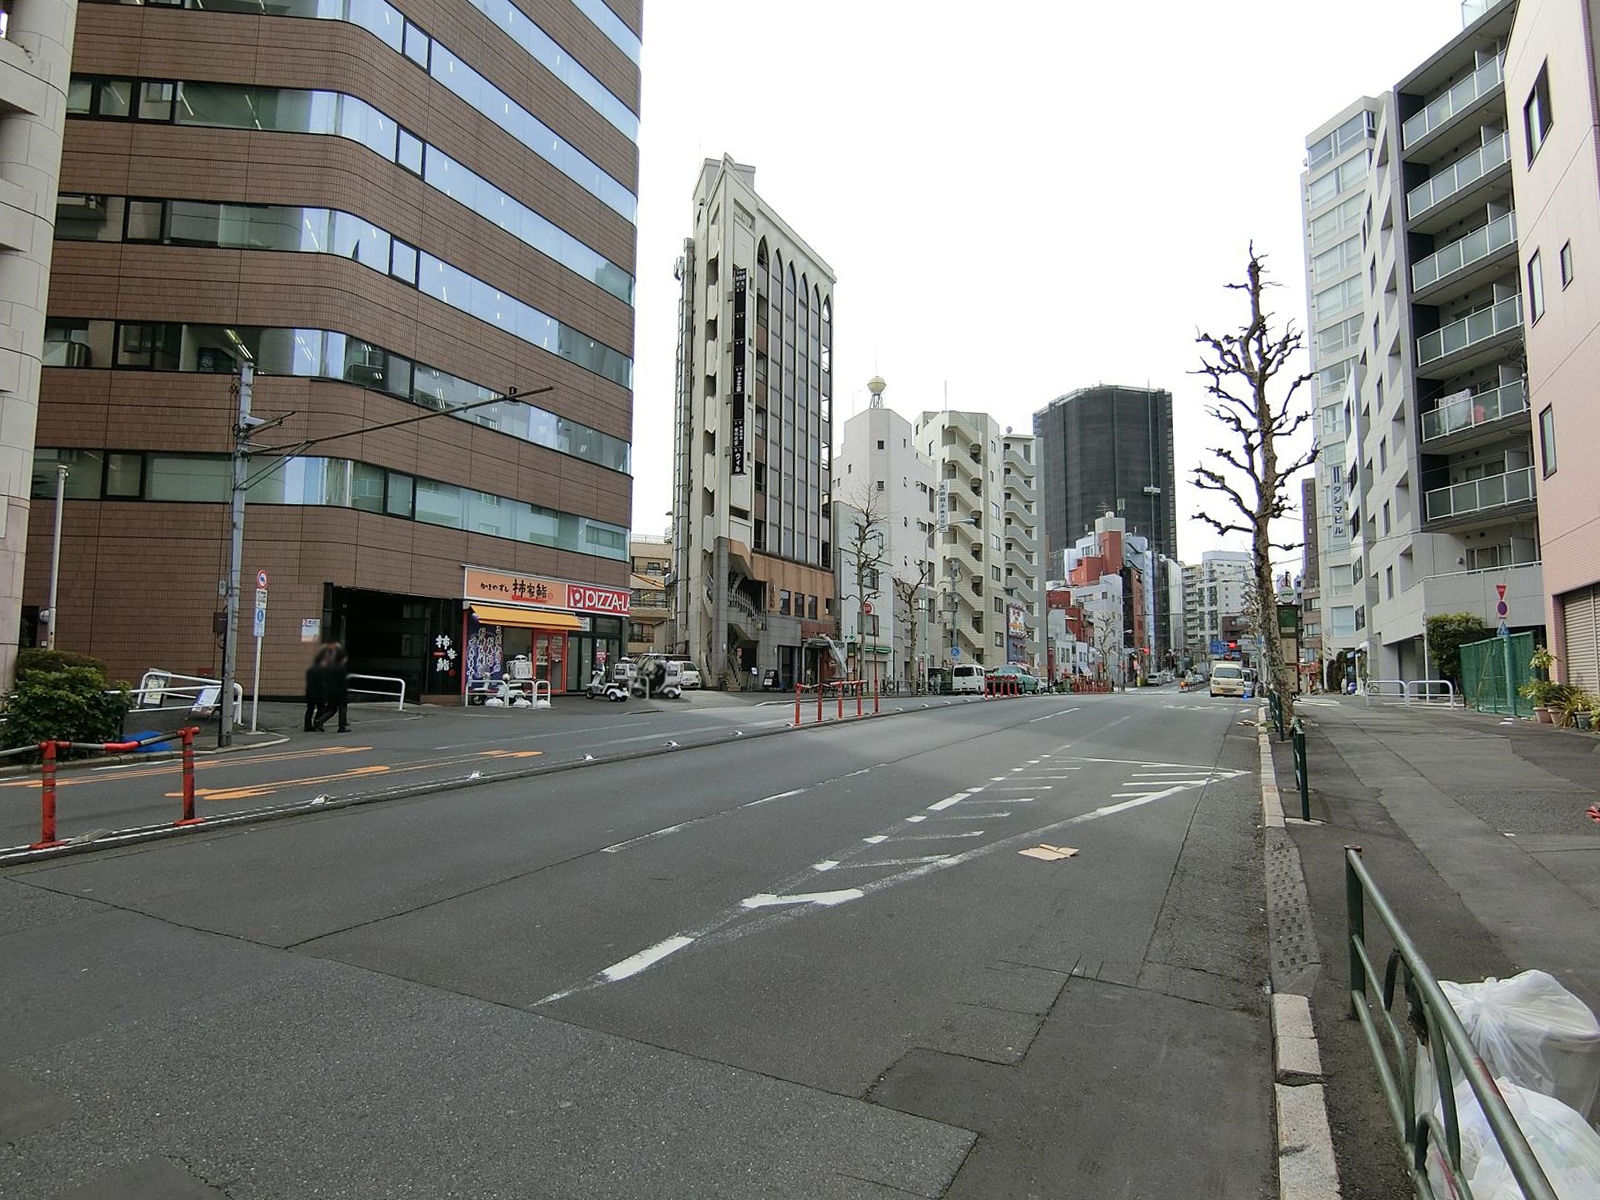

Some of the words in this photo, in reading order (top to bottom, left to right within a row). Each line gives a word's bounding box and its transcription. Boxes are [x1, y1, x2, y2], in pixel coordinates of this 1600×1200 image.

[1333, 486, 1343, 534] タジマビル
